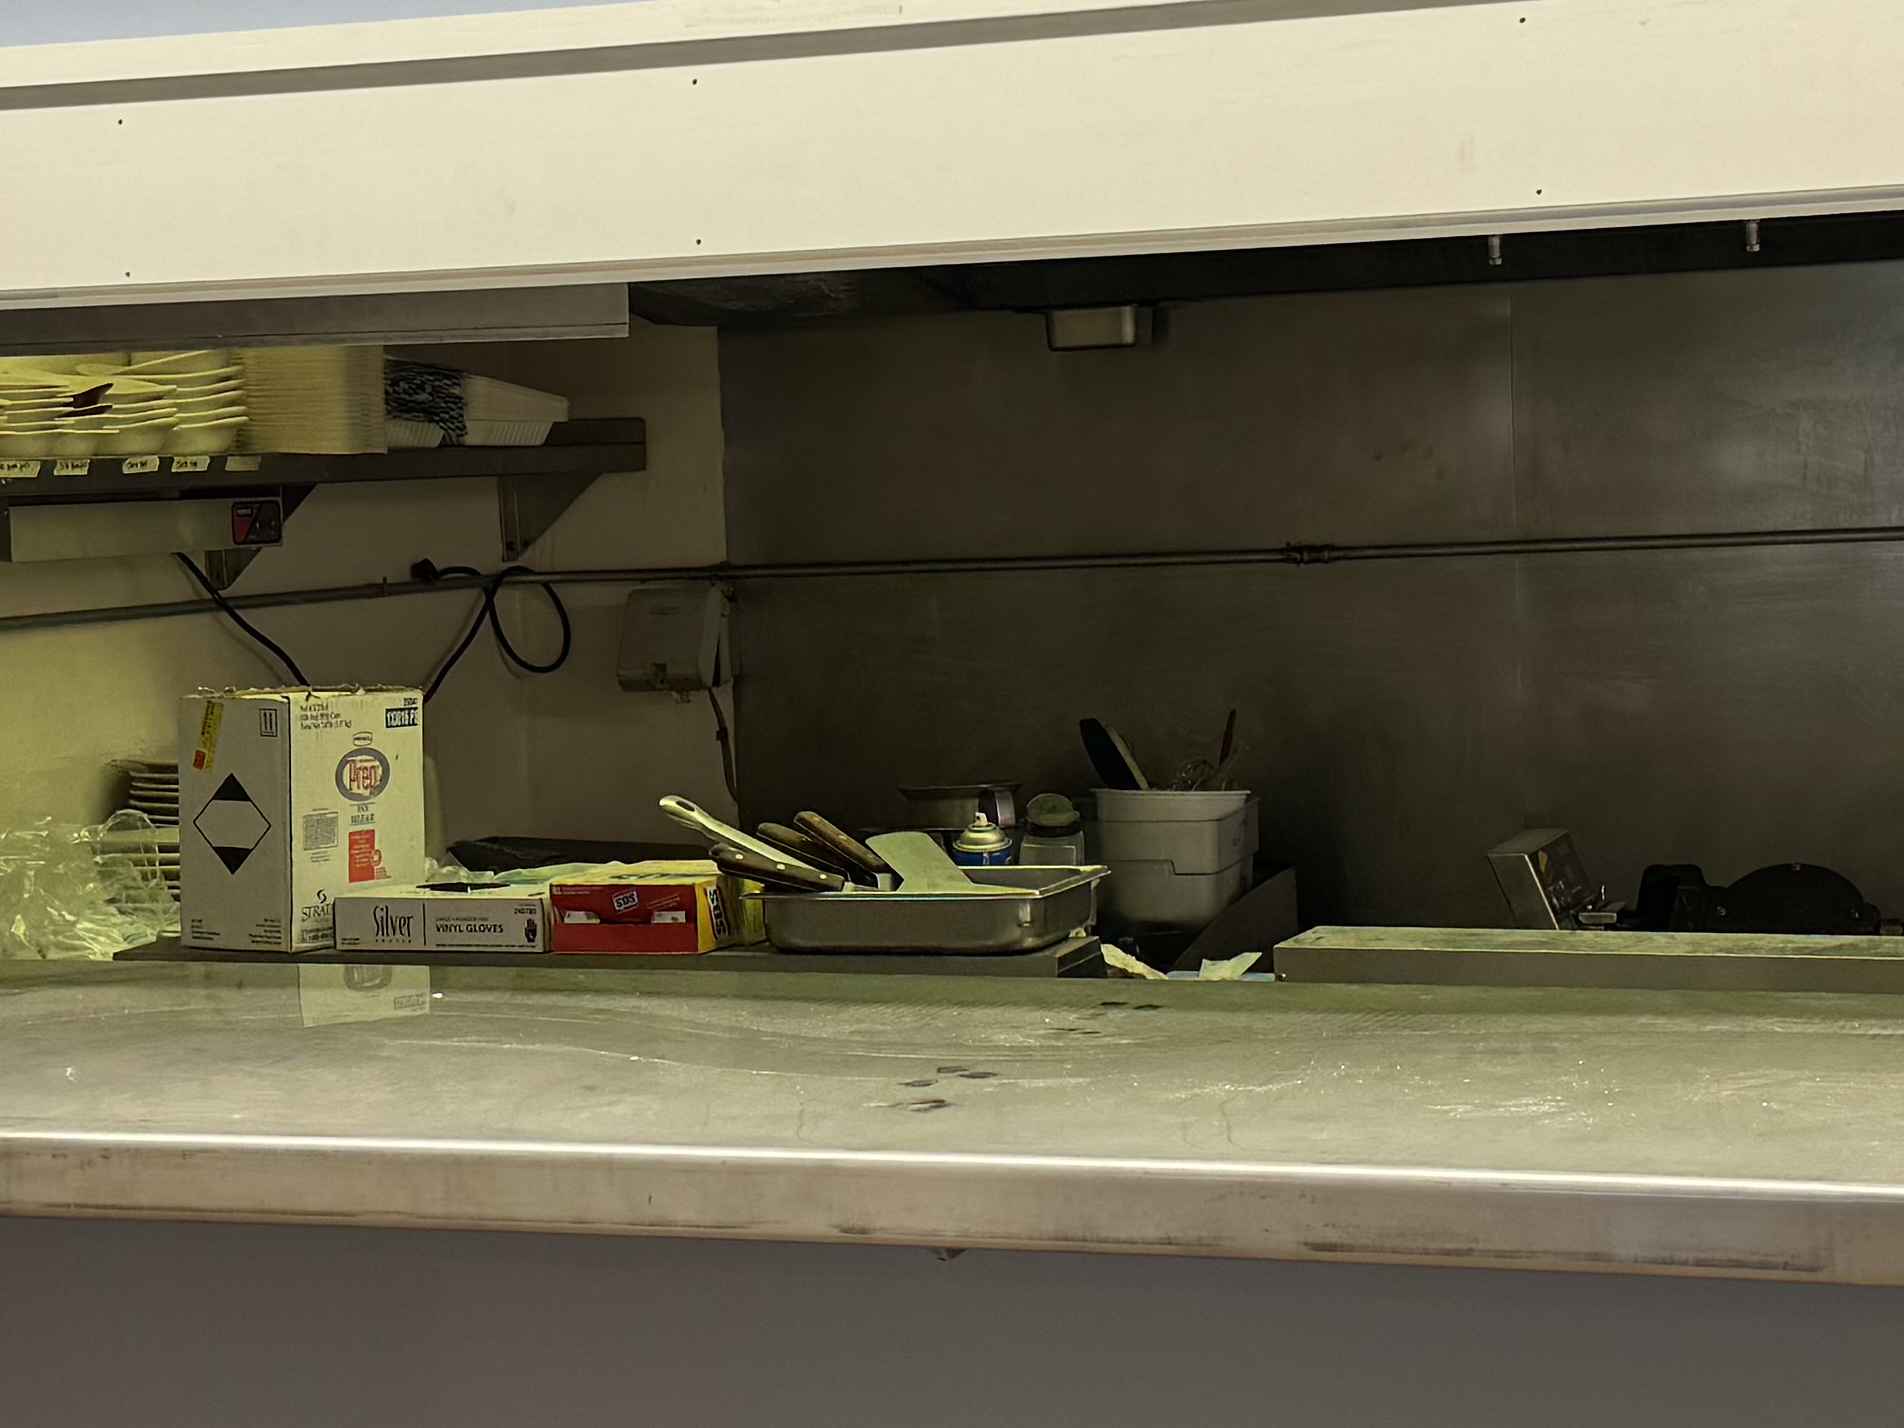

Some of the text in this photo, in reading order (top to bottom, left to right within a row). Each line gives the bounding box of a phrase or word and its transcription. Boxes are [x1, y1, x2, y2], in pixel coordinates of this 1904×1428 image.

[302, 904, 334, 921] STRAT
[373, 905, 415, 938] Silver
[435, 923, 504, 934] VINYL GLOVES
